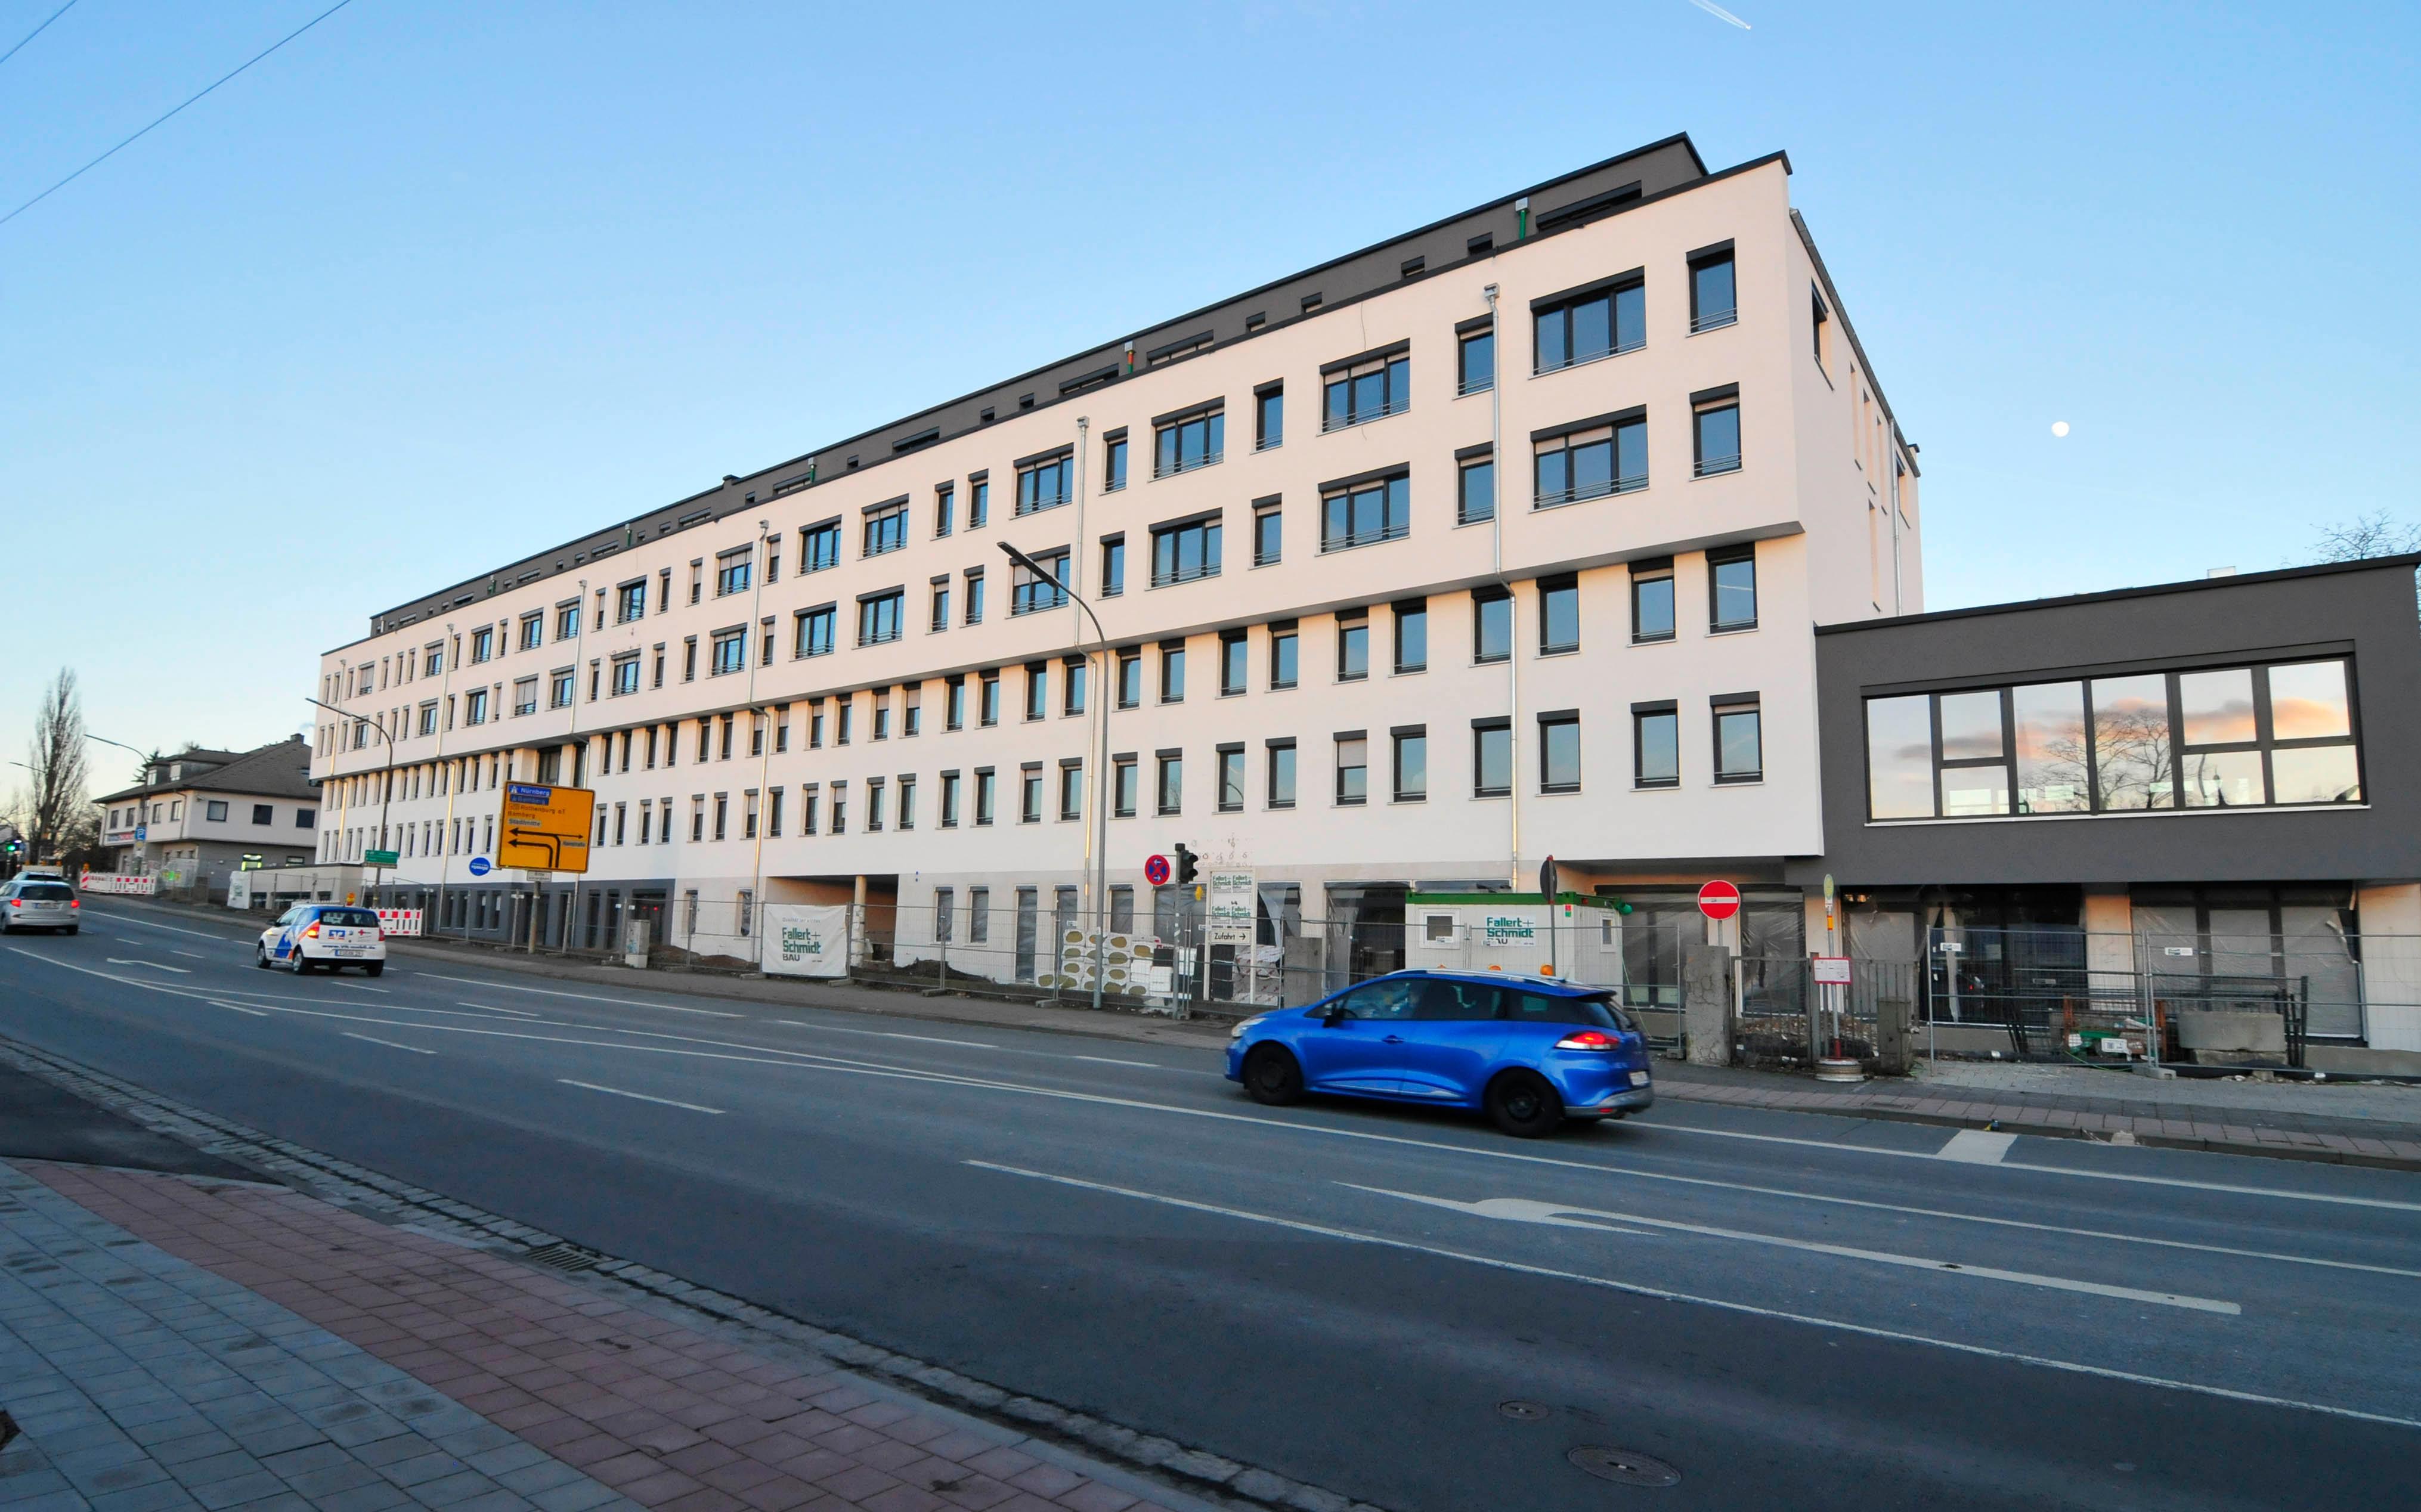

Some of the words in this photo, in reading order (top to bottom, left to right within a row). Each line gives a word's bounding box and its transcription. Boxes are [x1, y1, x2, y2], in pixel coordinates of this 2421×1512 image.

[521, 787, 550, 797] Nürnberg
[507, 811, 535, 819] Bamberg
[509, 818, 540, 826] Stadtmitte
[1214, 931, 1236, 940] Zufahrt
[1487, 928, 1534, 938] Schmidt
[782, 940, 821, 954] Schmidt
